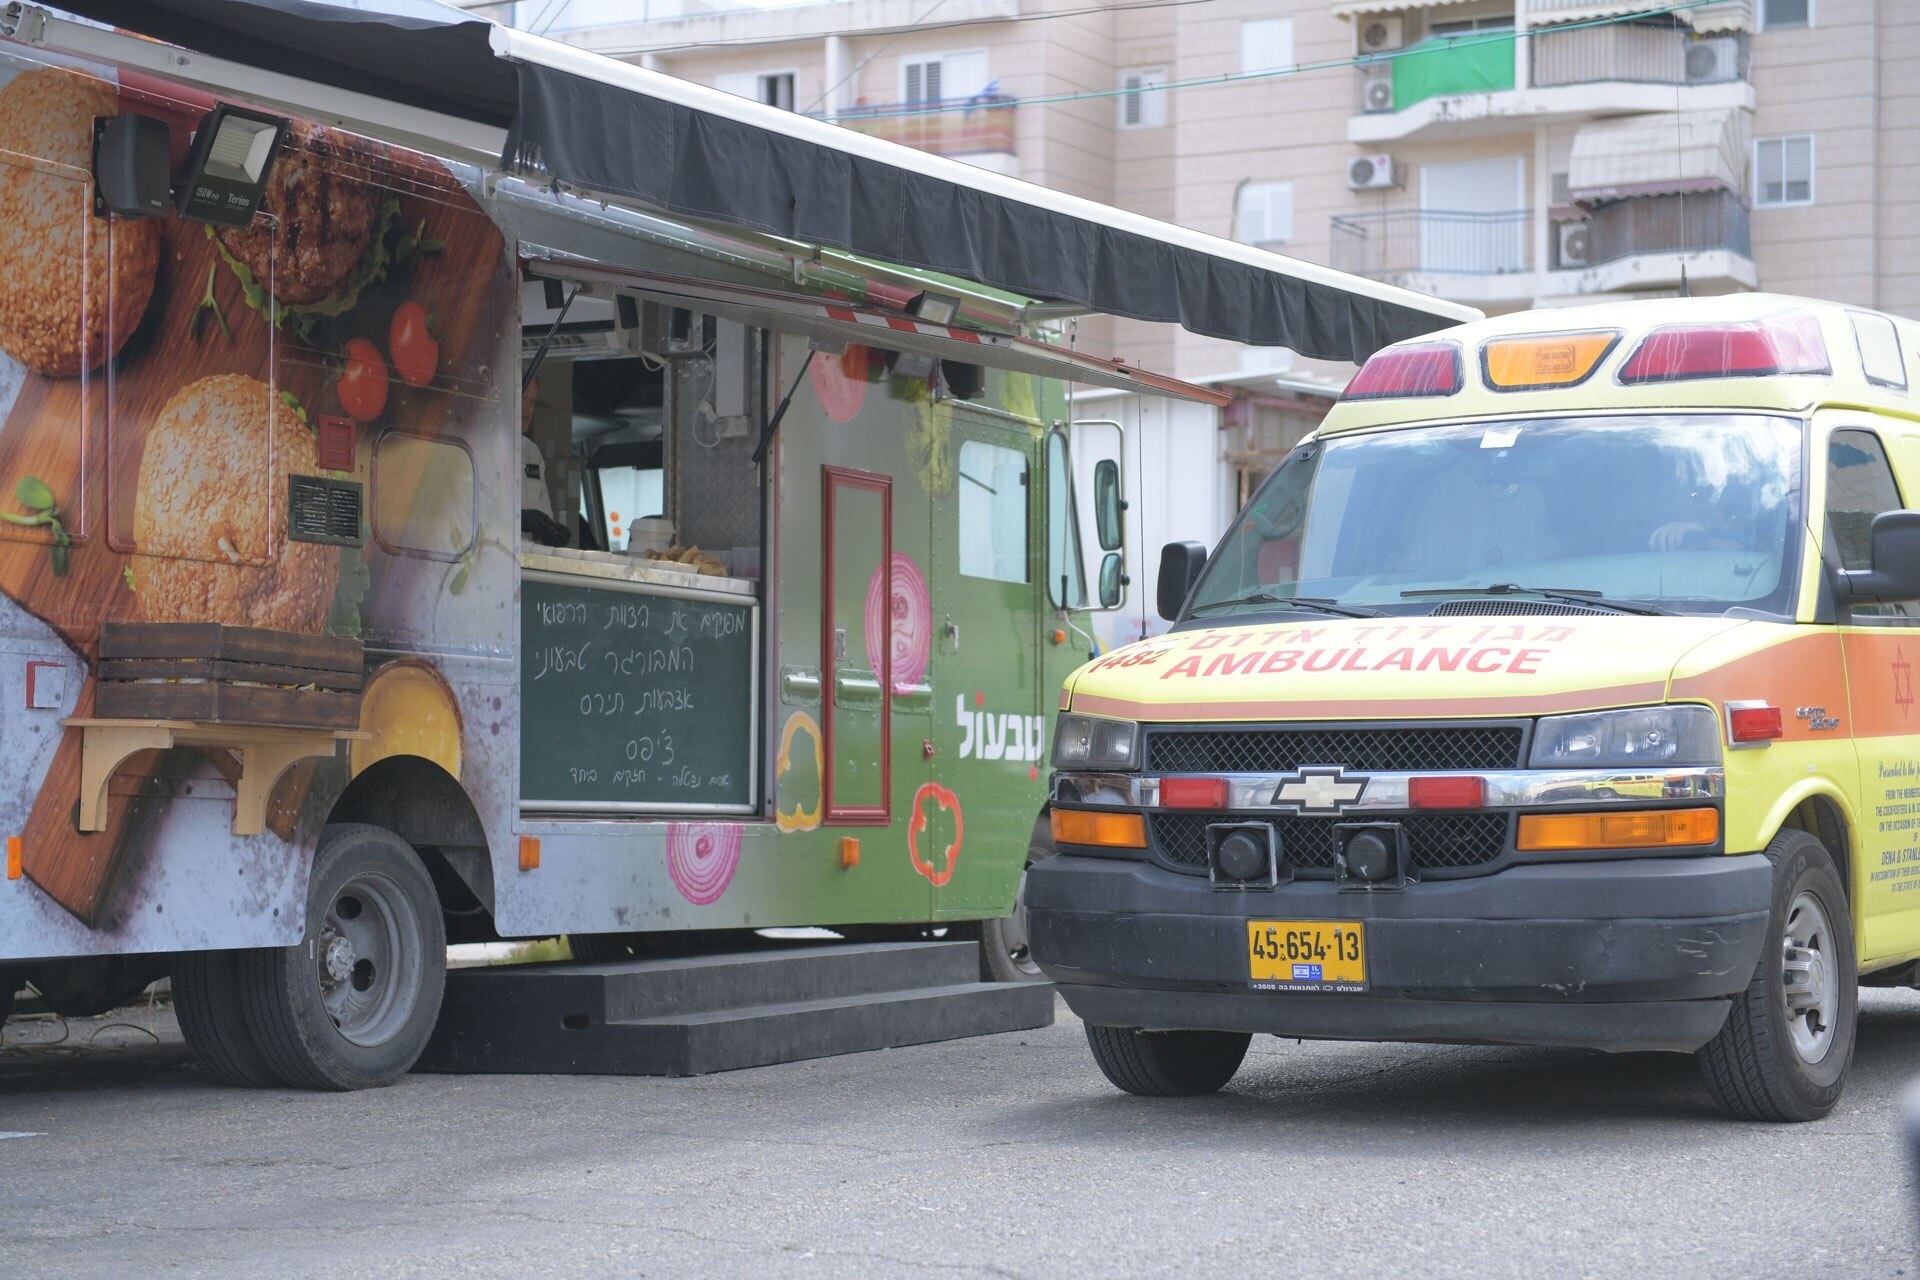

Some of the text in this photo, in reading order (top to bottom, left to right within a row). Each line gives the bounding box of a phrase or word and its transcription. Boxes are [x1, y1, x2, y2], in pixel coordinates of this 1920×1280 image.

[228, 193, 250, 206] Terios
[537, 602, 746, 639] מפנקים את הצוות הרפואי
[1186, 628, 1327, 651] אדום
[1352, 624, 1451, 642] דוד
[1468, 624, 1577, 644] מגן
[534, 641, 693, 680] המבורגר טבעוני
[1159, 646, 1551, 680] AMBULANCE
[580, 687, 694, 715] אצבעות תירס
[956, 693, 1045, 761] טבעול
[569, 767, 598, 784] ביחד
[613, 768, 646, 788] חזקים
